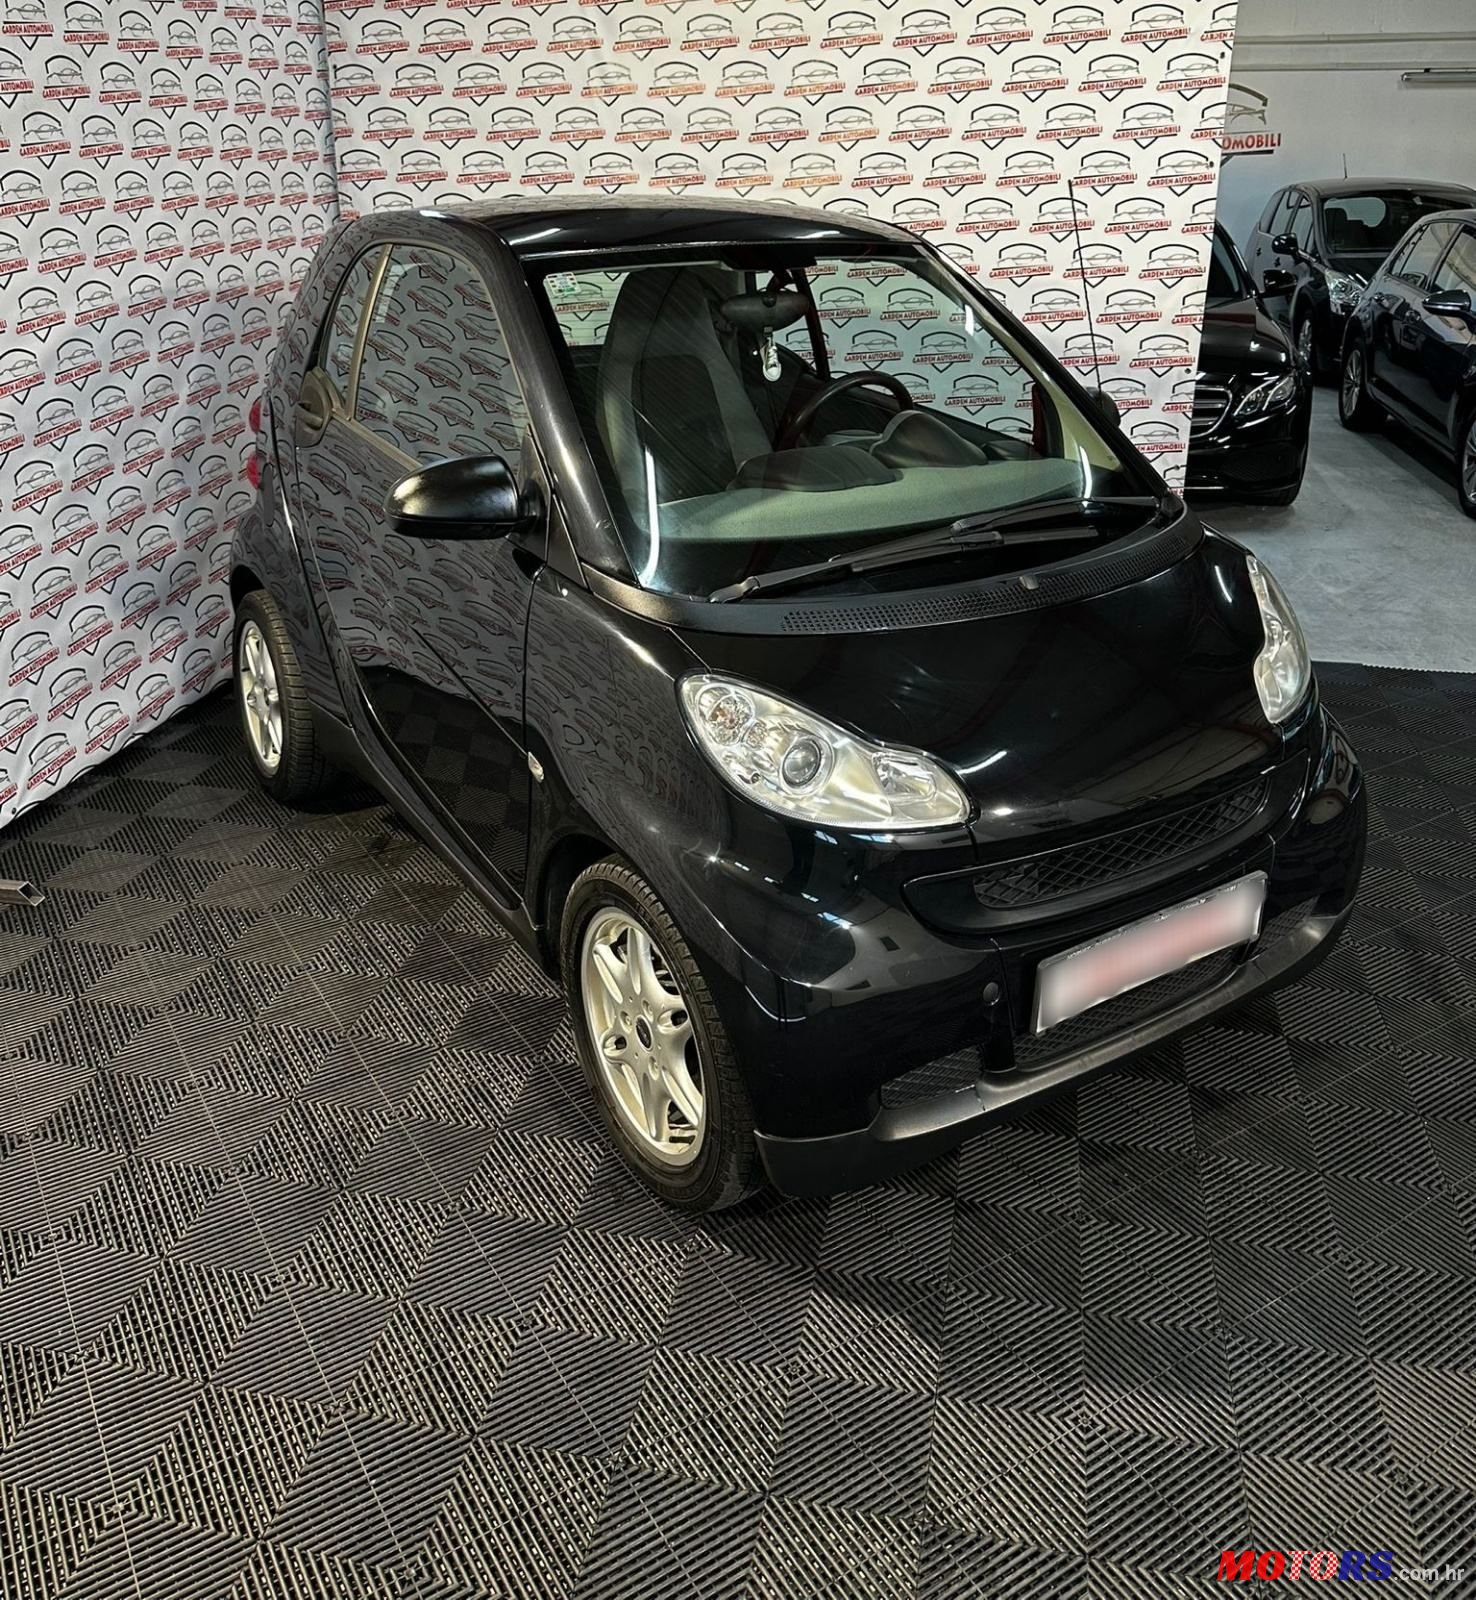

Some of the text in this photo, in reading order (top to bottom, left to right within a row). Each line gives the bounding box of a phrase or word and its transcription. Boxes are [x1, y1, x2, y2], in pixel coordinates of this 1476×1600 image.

[2, 24, 54, 34] GARDEN AUTOMOBILI
[1043, 28, 1111, 44] GARDEN AUTOMOBILI
[1121, 27, 1191, 43] GARDEN AUTOMOBILI
[63, 32, 110, 42] GARDEN AUTOMOBILI
[612, 37, 671, 52] GARDEN AUTOMOBILI
[679, 36, 740, 51] GARDEN AUTOMOBILI
[748, 35, 811, 50] GARDEN AUTOMOBILI
[820, 33, 883, 49] GARDEN AUTOMOBILI
[892, 32, 958, 47] GARDEN AUTOMOBILI
[967, 29, 1033, 45] GARDEN AUTOMOBILI
[783, 82, 845, 96] GARDEN AUTOMOBILI
[855, 80, 918, 95] GARDEN AUTOMOBILI
[927, 79, 992, 94] GARDEN AUTOMOBILI
[1002, 78, 1068, 92] GARDEN AUTOMOBILI
[1078, 77, 1146, 92] GARDEN AUTOMOBILI
[1156, 76, 1226, 91] GARDEN AUTOMOBILI
[42, 85, 91, 98] GARDEN AUTOMOBILI
[614, 129, 672, 142] GARDEN AUTOMOBILI
[680, 129, 739, 142] GARDEN AUTOMOBILI
[748, 129, 809, 143] GARDEN AUTOMOBILI
[888, 127, 952, 141] GARDEN AUTOMOBILI
[961, 126, 1026, 140] GARDEN AUTOMOBILI
[1036, 125, 1103, 140] GARDEN AUTOMOBILI
[1112, 125, 1180, 139] GARDEN AUTOMOBILI
[19, 141, 72, 156] GARDEN AUTOMOBILI
[1222, 133, 1281, 150] OMOBILI
[671, 174, 706, 184] AUTOMOBILI
[851, 174, 913, 188] GARDEN AUTOMOBILI
[922, 173, 986, 187] GARDEN AUTOMOBILI
[995, 173, 1061, 187] GARDEN AUTOMOBILI
[1070, 173, 1137, 187] GARDEN AUTOMOBILI
[1147, 173, 1216, 186] GARDEN AUTOMOBILI
[58, 196, 106, 214] GARDEN AUTOMOBILI
[955, 219, 1020, 233] GARDEN AUTOMOBILI
[1104, 220, 1171, 233] GARDEN AUTOMOBILI
[37, 252, 87, 273] GARDEN AUTOMOBILI
[989, 265, 1053, 278] GARDEN AUTOMOBILI
[1138, 266, 1206, 279] GARDEN AUTOMOBILI
[15, 310, 67, 334] GARDEN AUTOMOBILI
[1022, 310, 1086, 322] GARDEN AUTOMOBILI
[1096, 311, 1162, 323] GARDEN AUTOMOBILI
[1129, 356, 1195, 368] GARDEN AUTOMOBILI
[54, 359, 103, 385] GARDEN AUTOMOBILI
[33, 418, 83, 446] GARDEN AUTOMOBILI
[11, 479, 64, 511] GARDEN AUTOMOBILI
[50, 521, 99, 554] GARDEN AUTOMOBILI
[29, 582, 79, 619] GARDEN AUTOMOBILI
[67, 619, 114, 656] GARDEN AUTOMOBILI
[8, 646, 60, 687] GARDEN AUTOMOBILI
[47, 681, 94, 722] GARDEN AUTOMOBILI
[27, 745, 77, 790] GARDEN AUTOMOBILI
